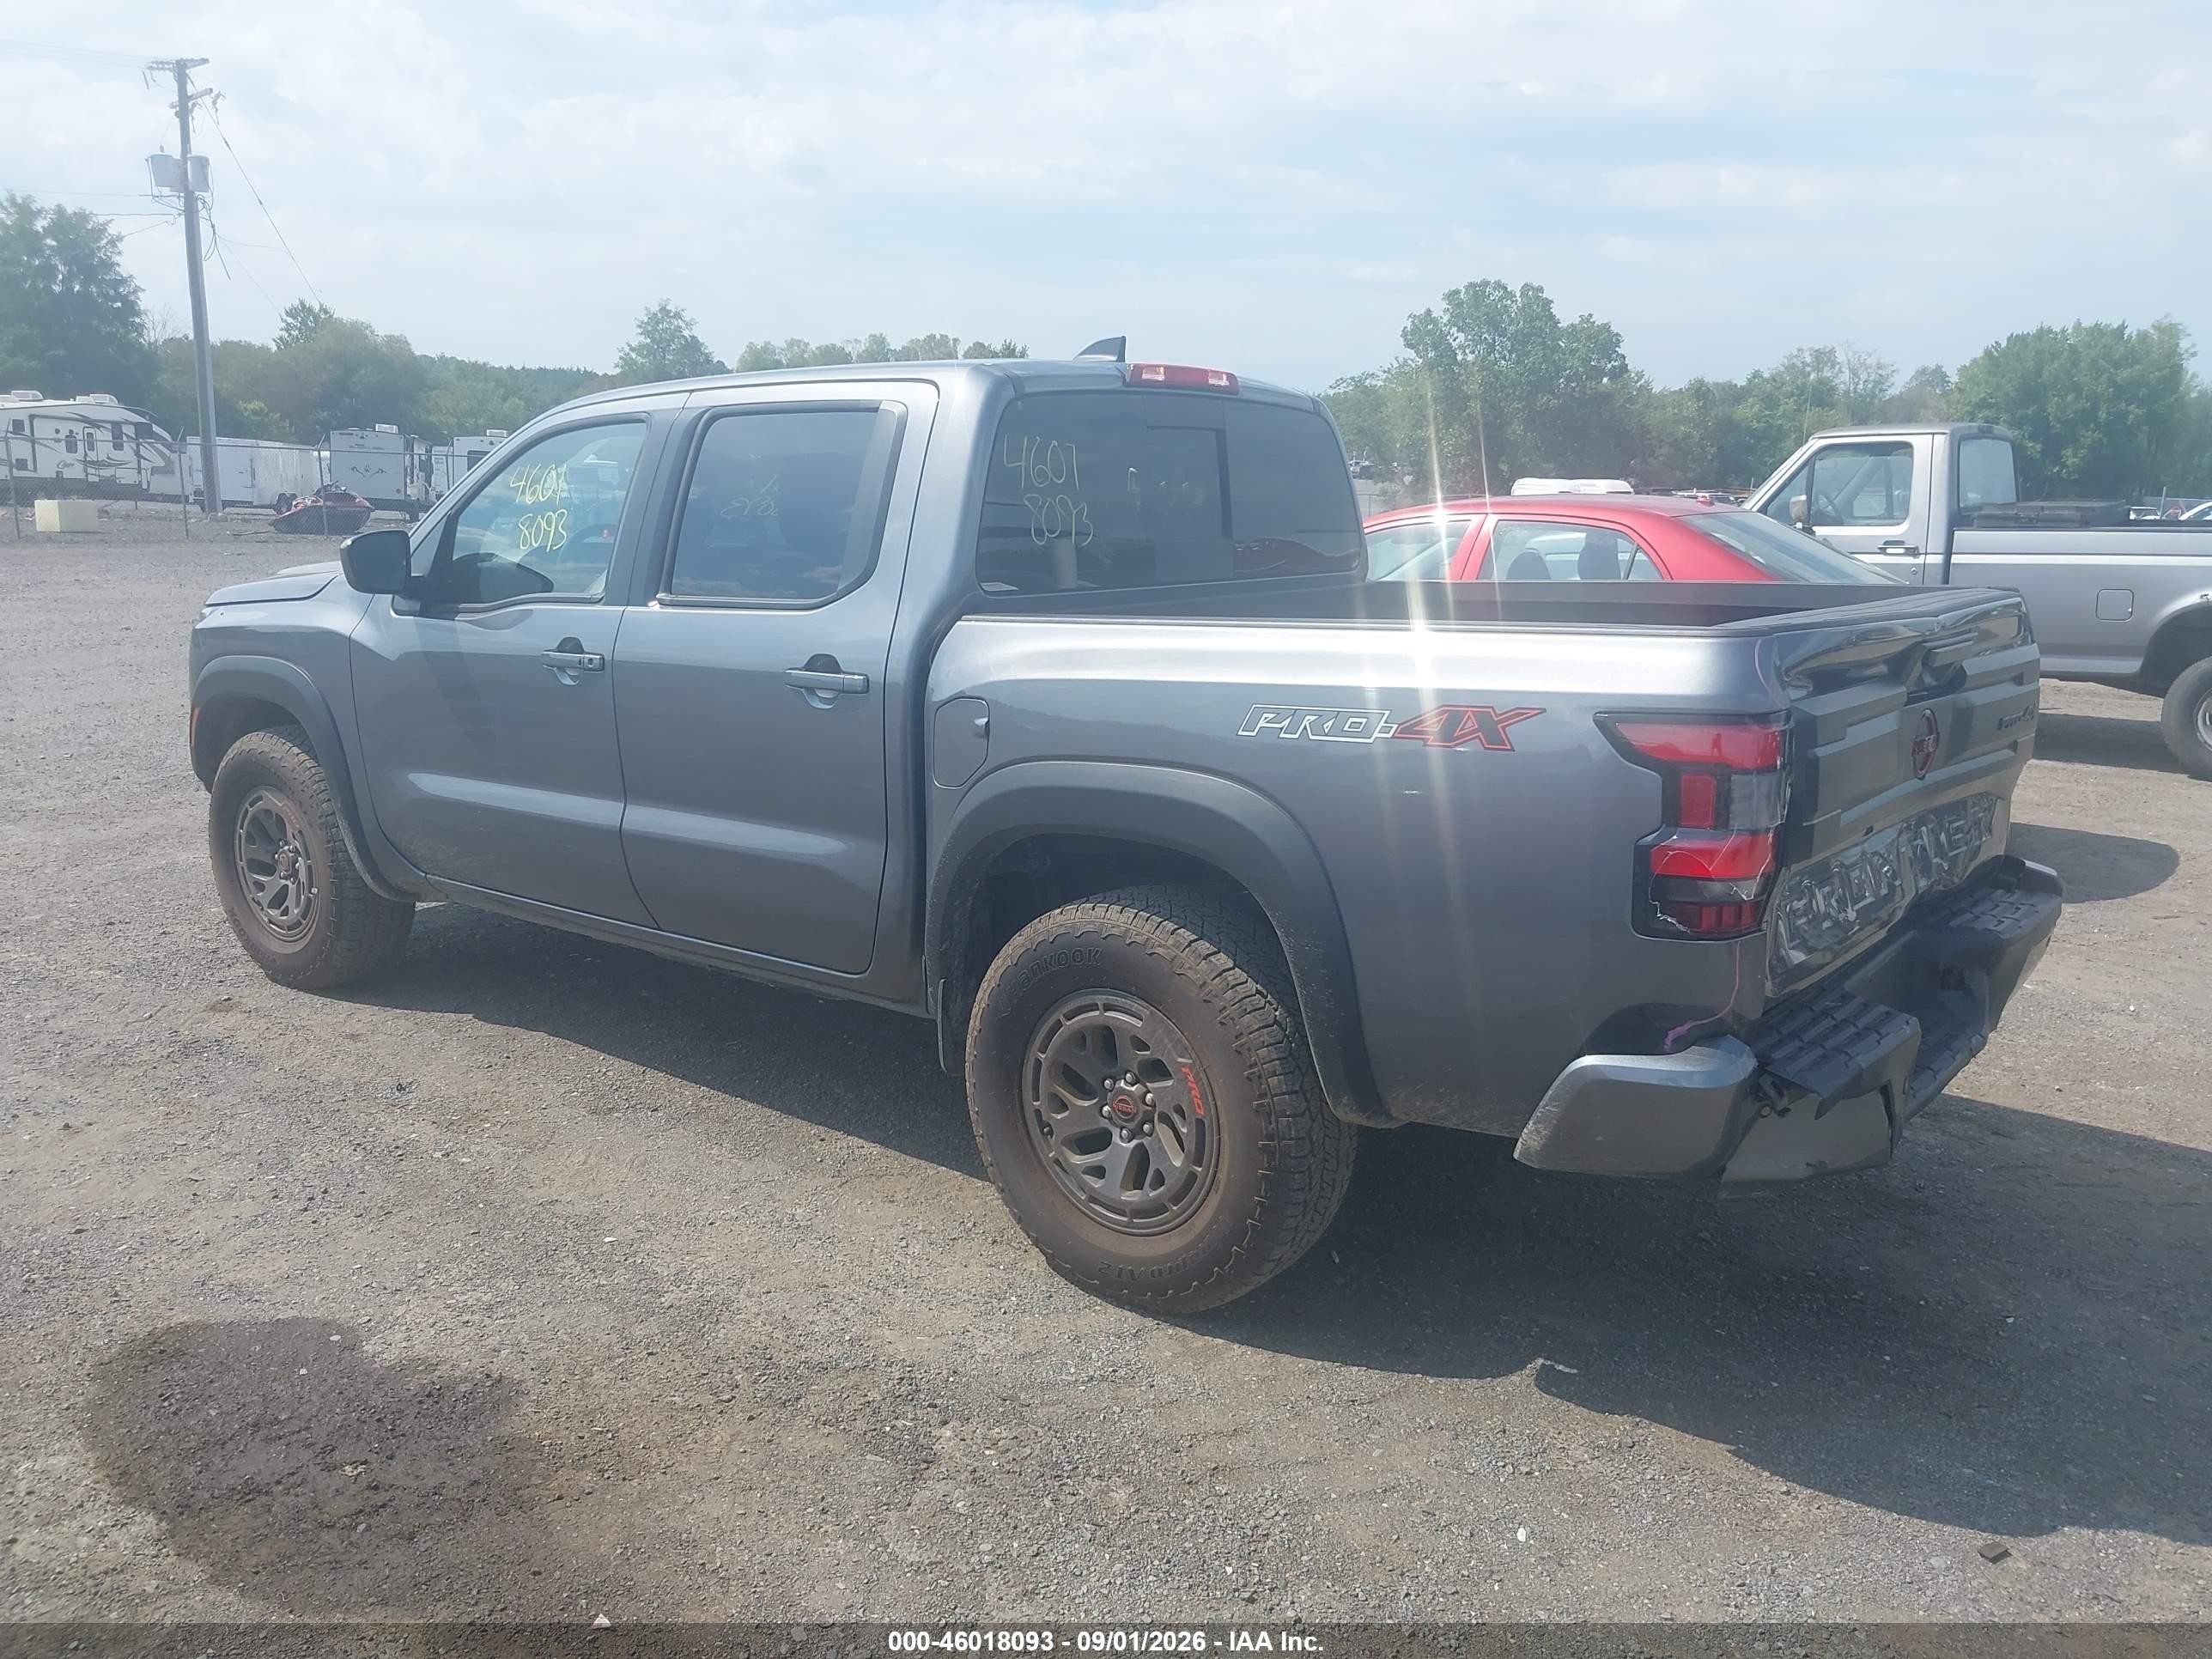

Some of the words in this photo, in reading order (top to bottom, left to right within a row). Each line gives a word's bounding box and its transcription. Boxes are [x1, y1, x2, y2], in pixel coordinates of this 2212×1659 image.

[1003, 434, 1079, 490] 4607
[518, 508, 568, 552] 8093
[1023, 494, 1093, 546] 8093
